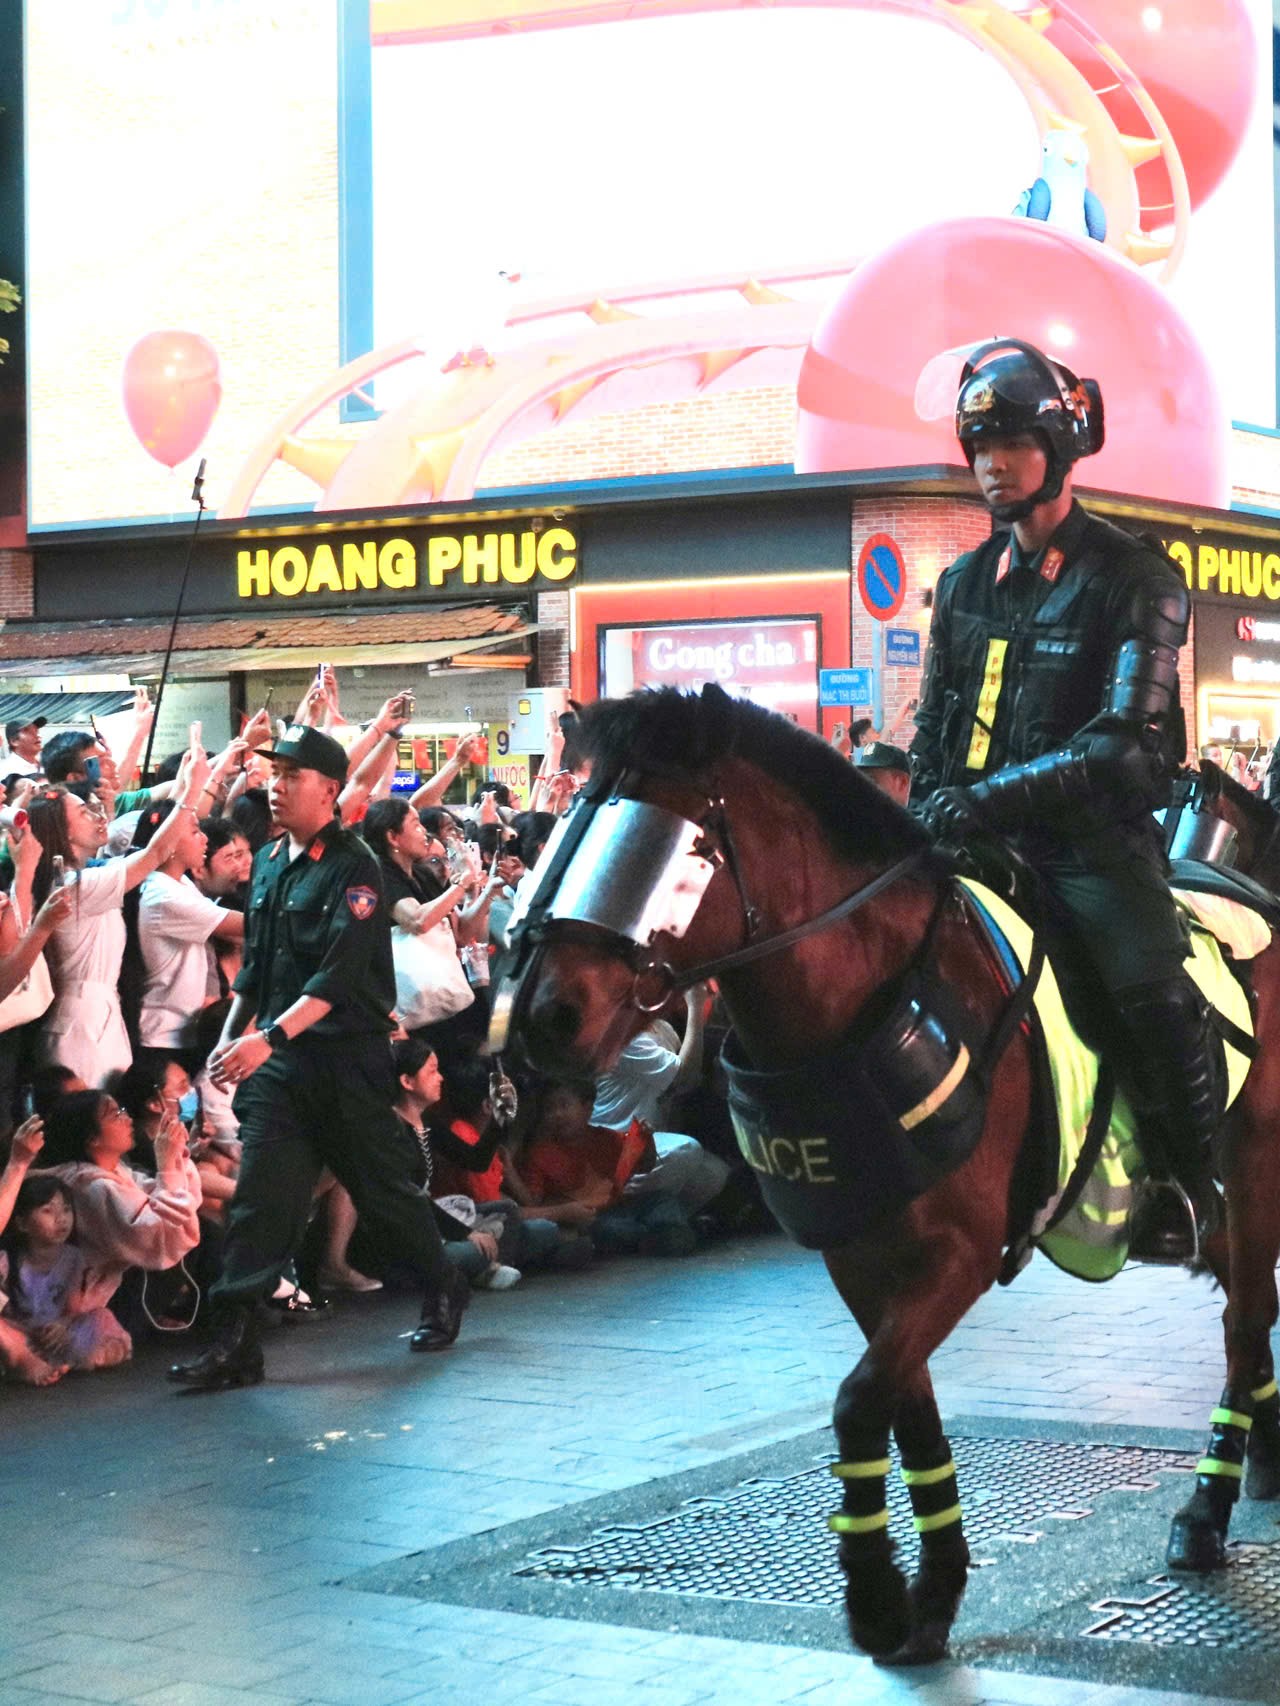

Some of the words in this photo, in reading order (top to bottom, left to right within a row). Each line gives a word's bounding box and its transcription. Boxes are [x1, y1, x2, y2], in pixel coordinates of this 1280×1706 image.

[237, 538, 416, 597] HOANG
[429, 528, 577, 586] PHUC
[650, 638, 734, 679] Gong
[738, 633, 795, 667] cha
